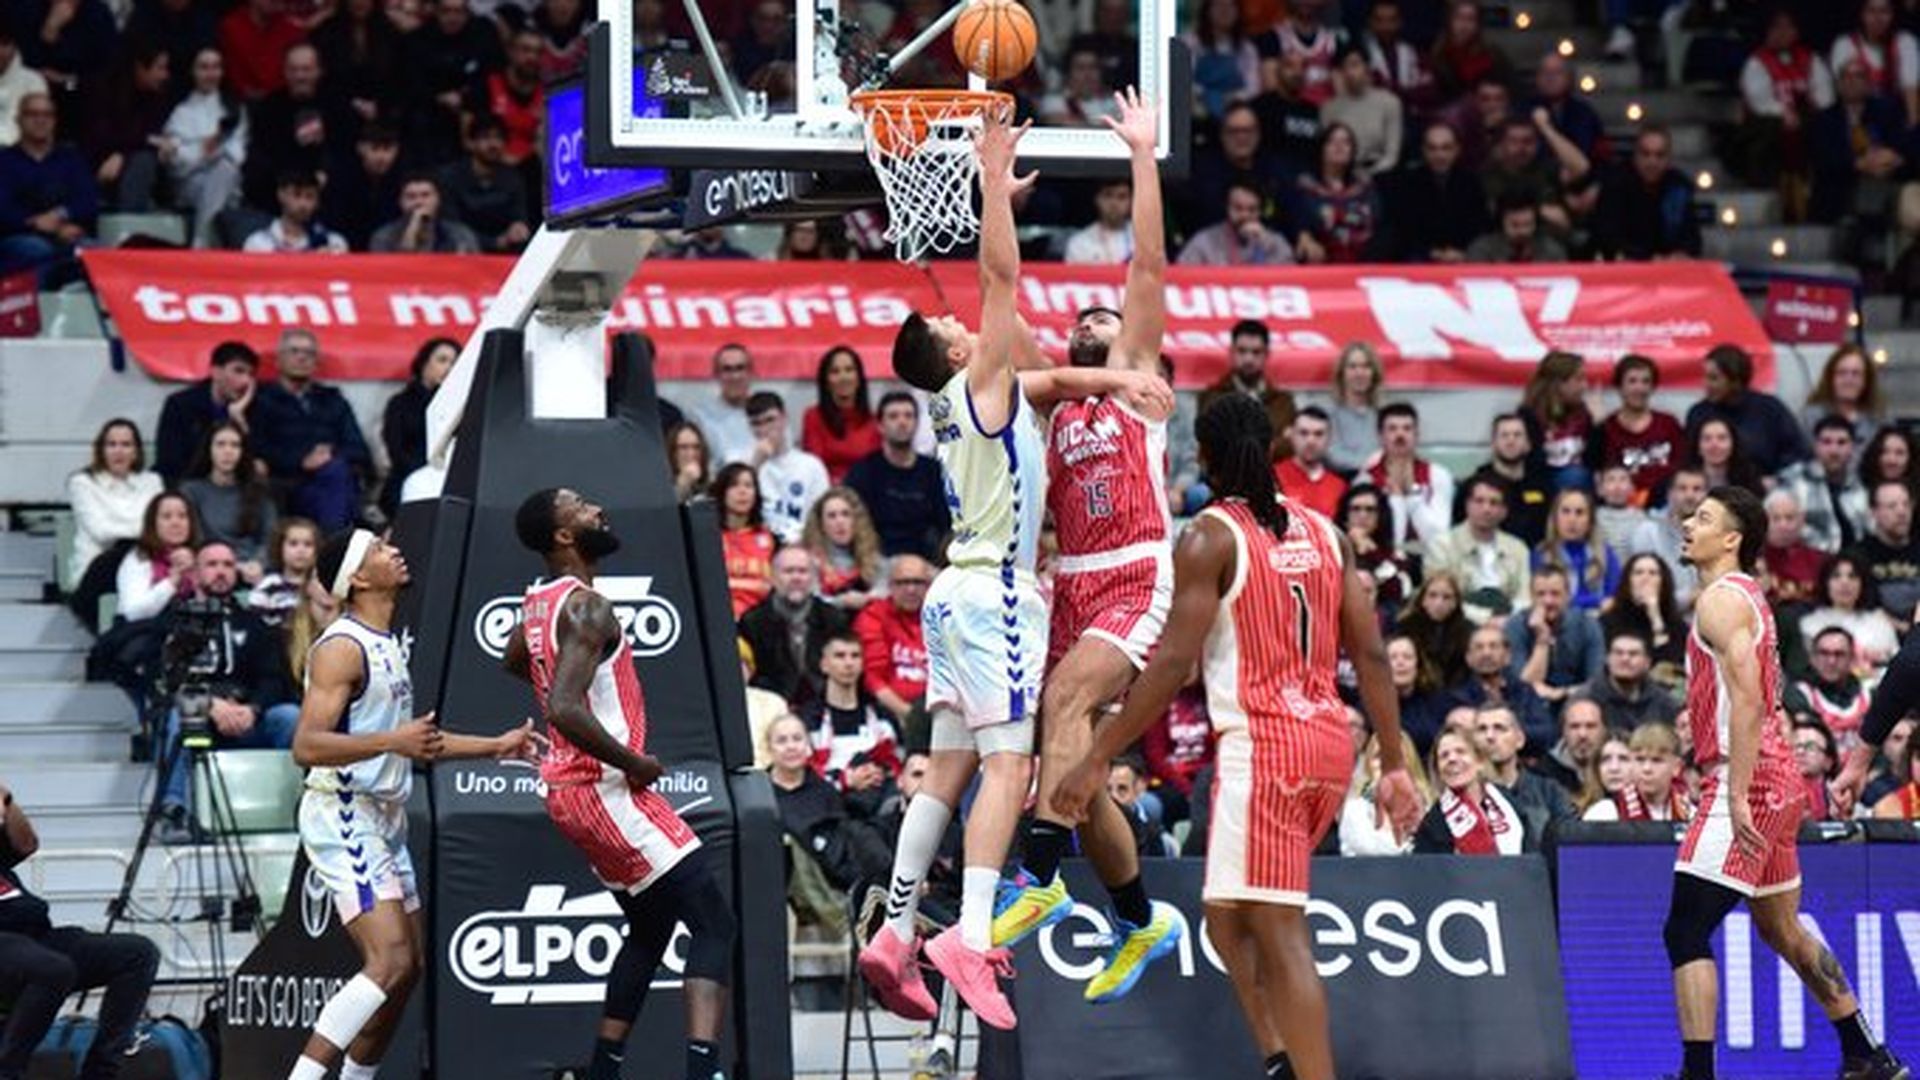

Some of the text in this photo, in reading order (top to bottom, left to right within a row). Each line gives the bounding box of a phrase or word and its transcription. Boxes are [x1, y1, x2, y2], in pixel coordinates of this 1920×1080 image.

[134, 281, 910, 328] tomi muinaria
[1288, 580, 1312, 672] 1
[456, 771, 507, 794] Uno
[1037, 899, 1507, 980] eesa
[269, 975, 299, 1029] GO
